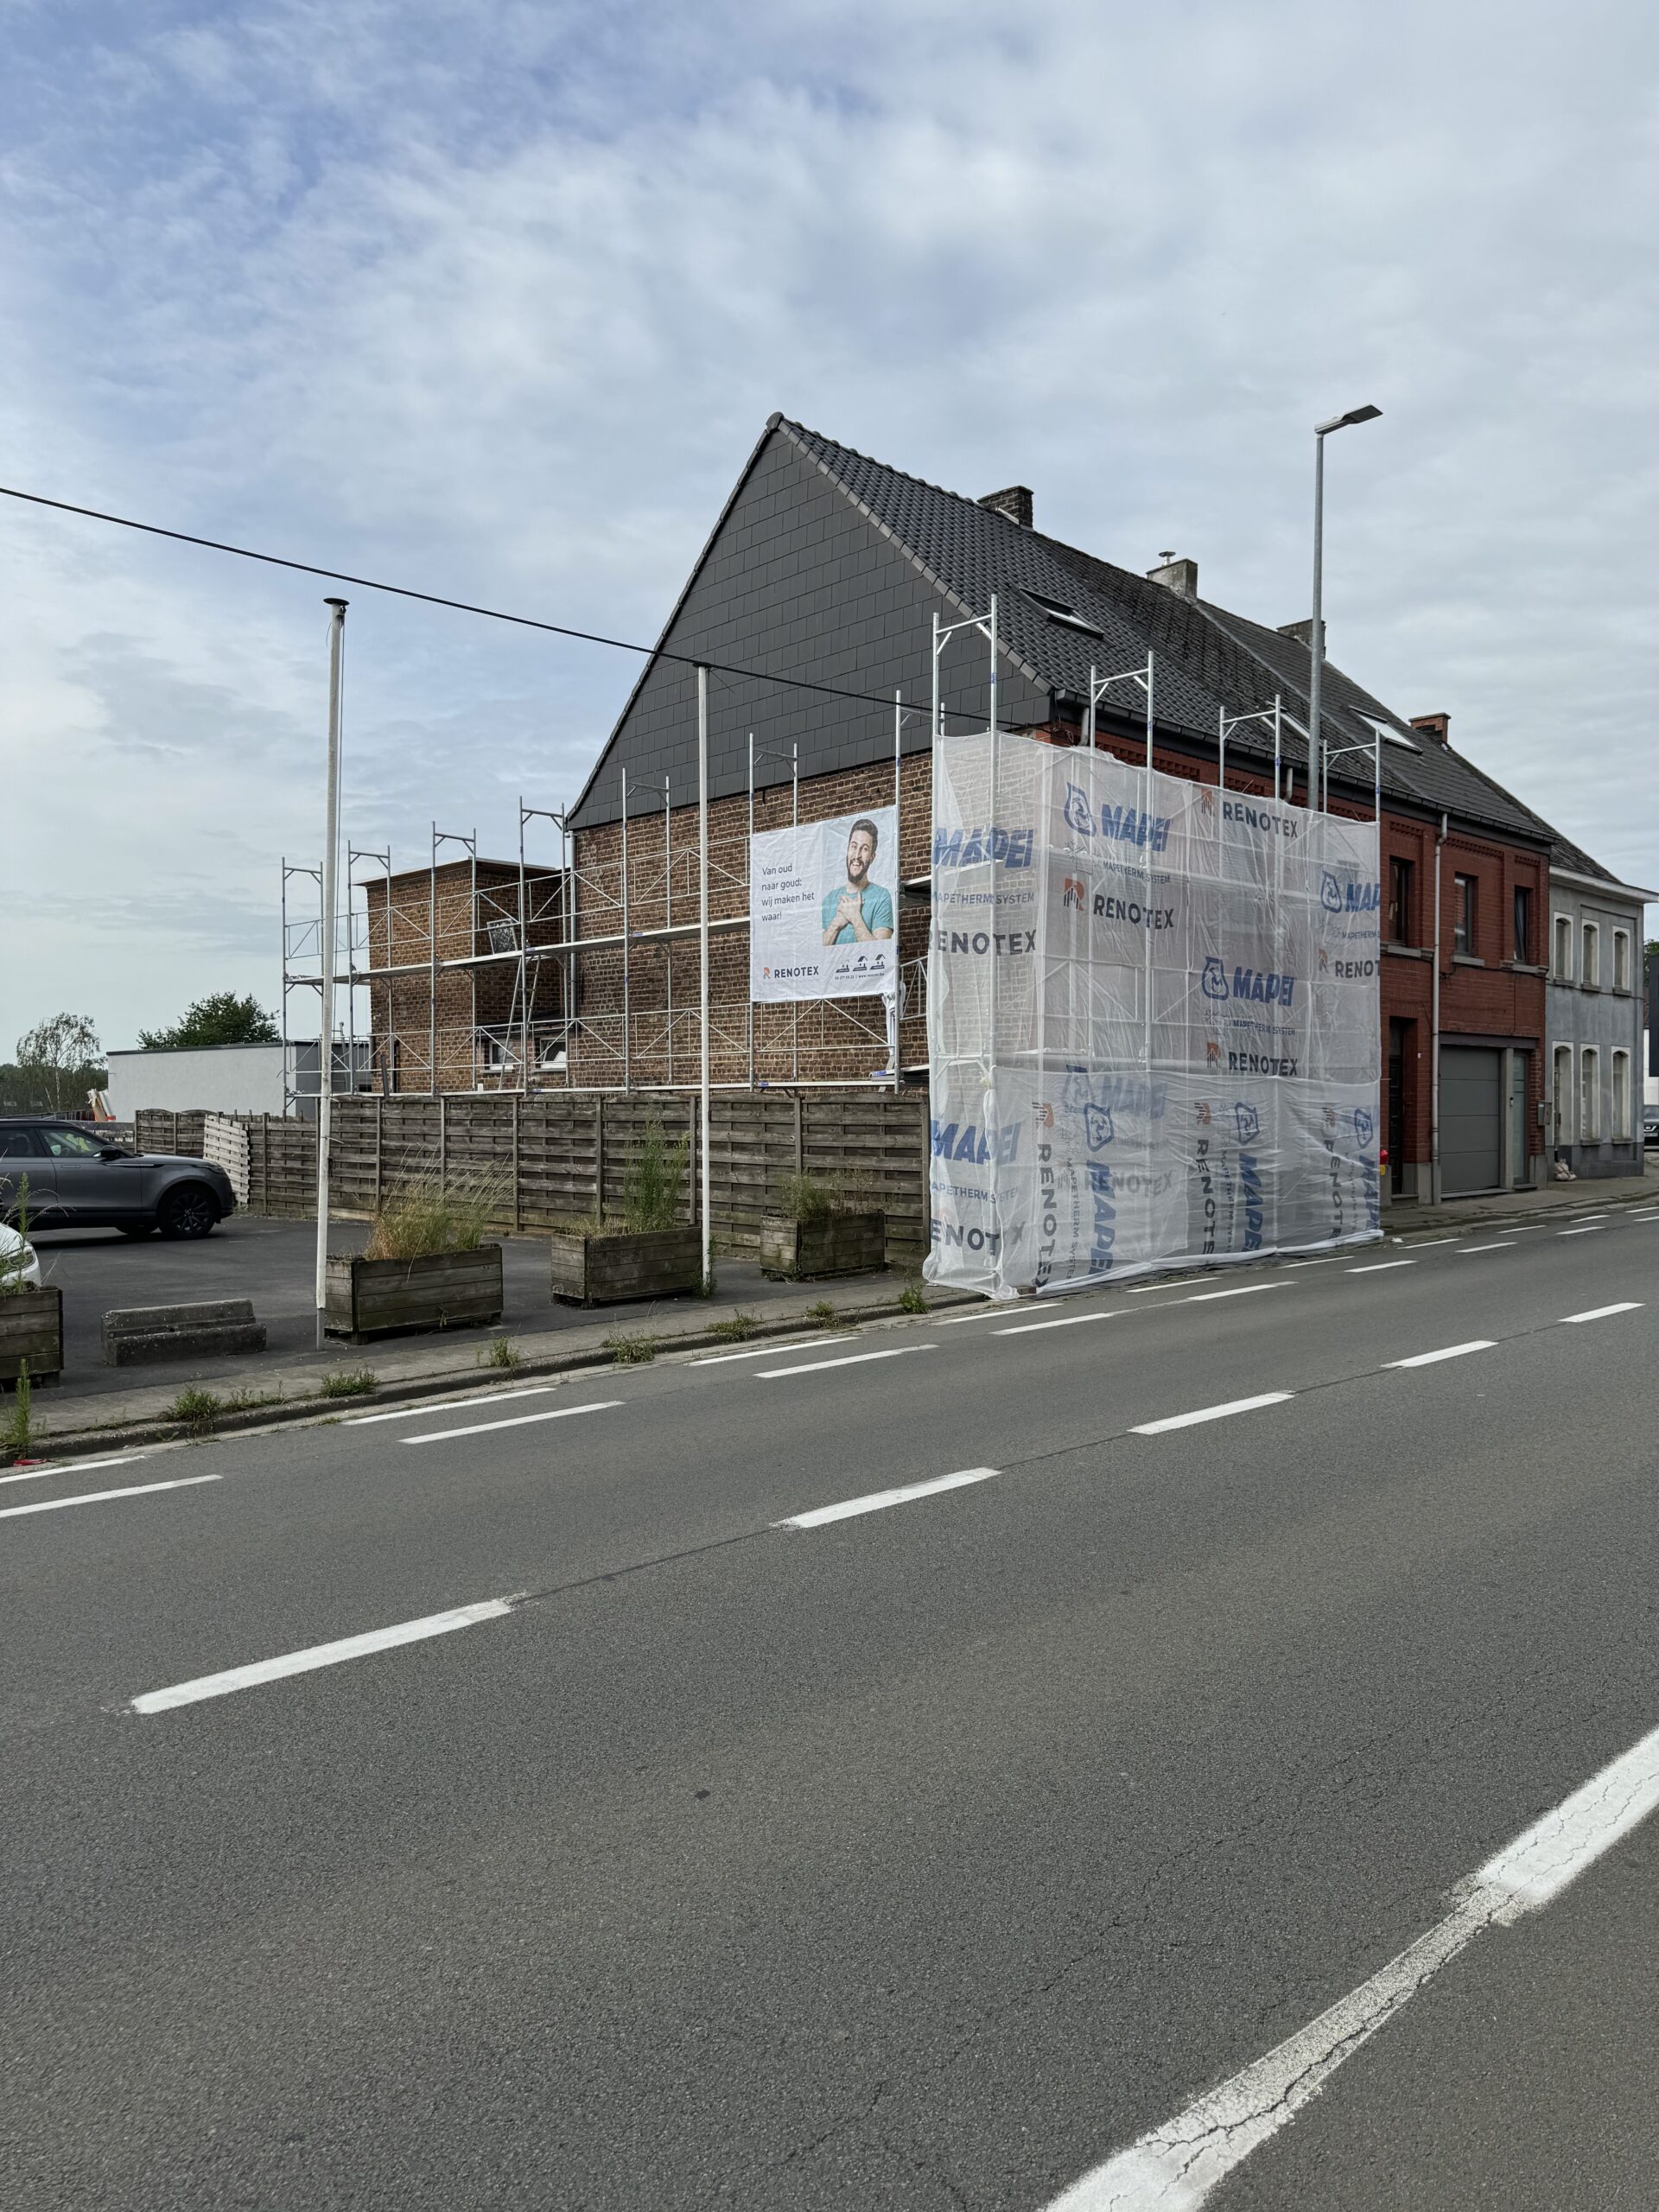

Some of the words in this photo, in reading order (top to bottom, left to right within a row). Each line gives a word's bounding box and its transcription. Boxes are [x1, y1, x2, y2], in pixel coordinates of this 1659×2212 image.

[1102, 804, 1171, 852] MAPEI
[1223, 801, 1298, 838] RENOTEX
[932, 828, 1034, 868] MAPEI
[762, 867, 777, 875] Van
[779, 863, 792, 874] oud
[761, 882, 779, 891] naar
[780, 878, 802, 891] goud:
[996, 892, 1034, 905] SYSTEM
[761, 896, 772, 907] wij
[774, 894, 800, 905] maken
[803, 892, 815, 901] het
[1093, 894, 1174, 929] RENOTEX
[761, 911, 782, 921] waar!
[774, 966, 819, 978] RENOTEX
[1233, 966, 1296, 1007] MAPEI
[1229, 1052, 1298, 1076] RENOTEX
[931, 1120, 1021, 1166] MAPEI
[931, 1181, 988, 1202] APETHERM
[1066, 1157, 1080, 1238] MAPETHERM
[1239, 1153, 1263, 1252] MAPE
